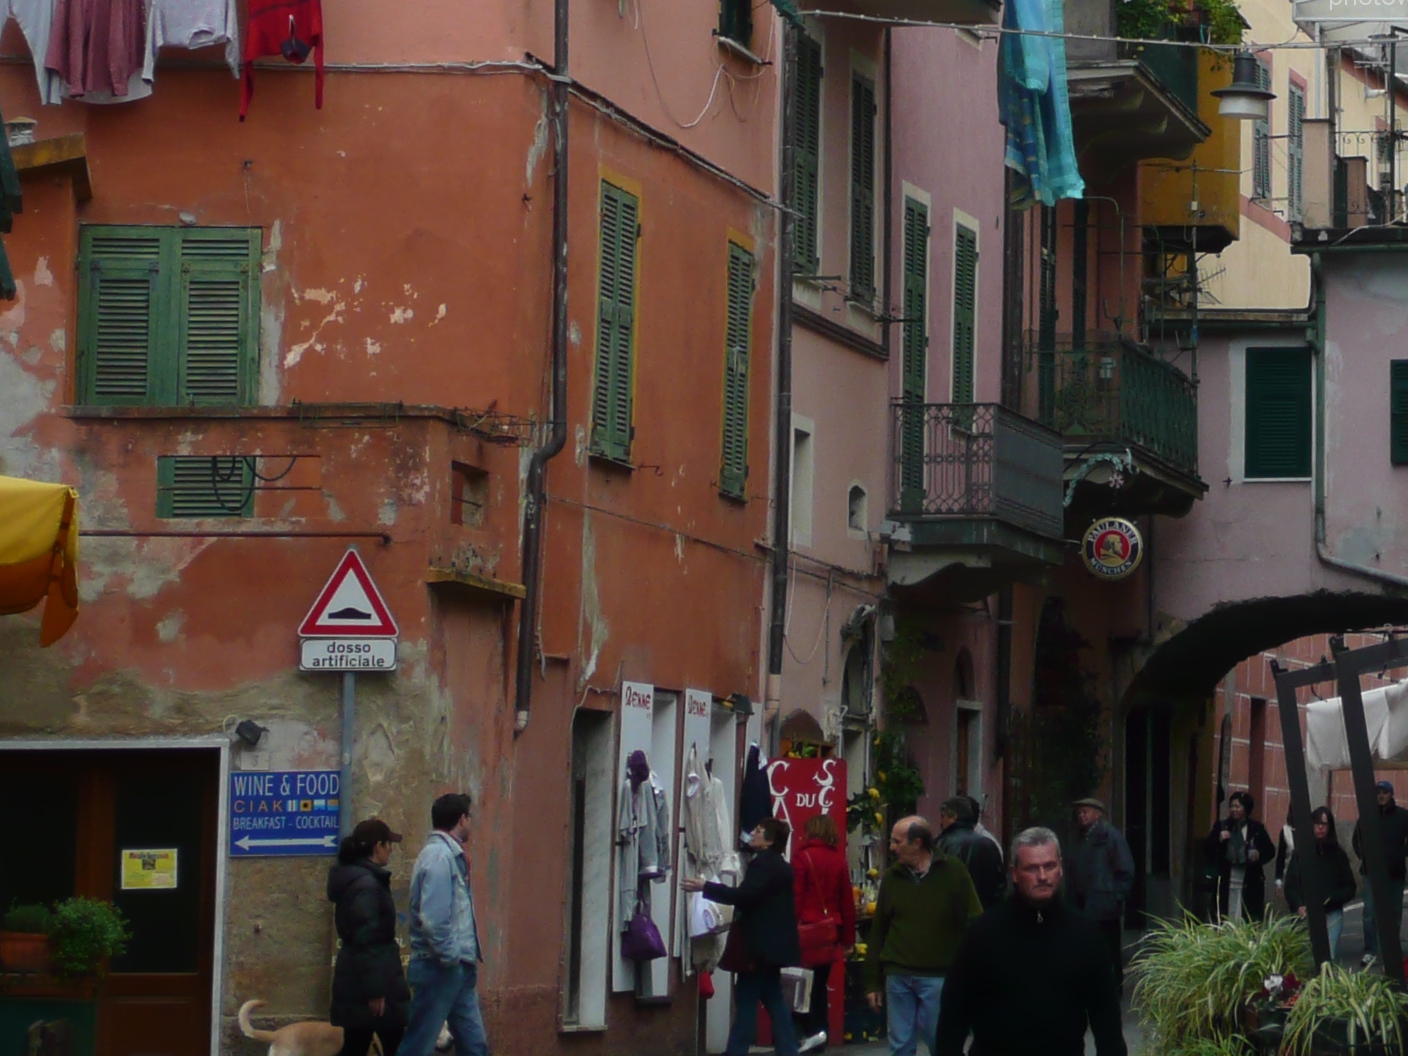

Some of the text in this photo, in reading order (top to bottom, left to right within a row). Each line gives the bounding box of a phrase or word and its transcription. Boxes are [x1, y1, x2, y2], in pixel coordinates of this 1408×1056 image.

[1087, 520, 1138, 545] PAULANER
[326, 642, 371, 653] dosso
[312, 655, 385, 667] artificiale
[234, 774, 340, 796] WINE & FOOD
[233, 800, 283, 813] CIAK
[796, 793, 817, 808] DU
[233, 816, 286, 830] BREAKFAST
[295, 816, 340, 829] COCKTAIL
